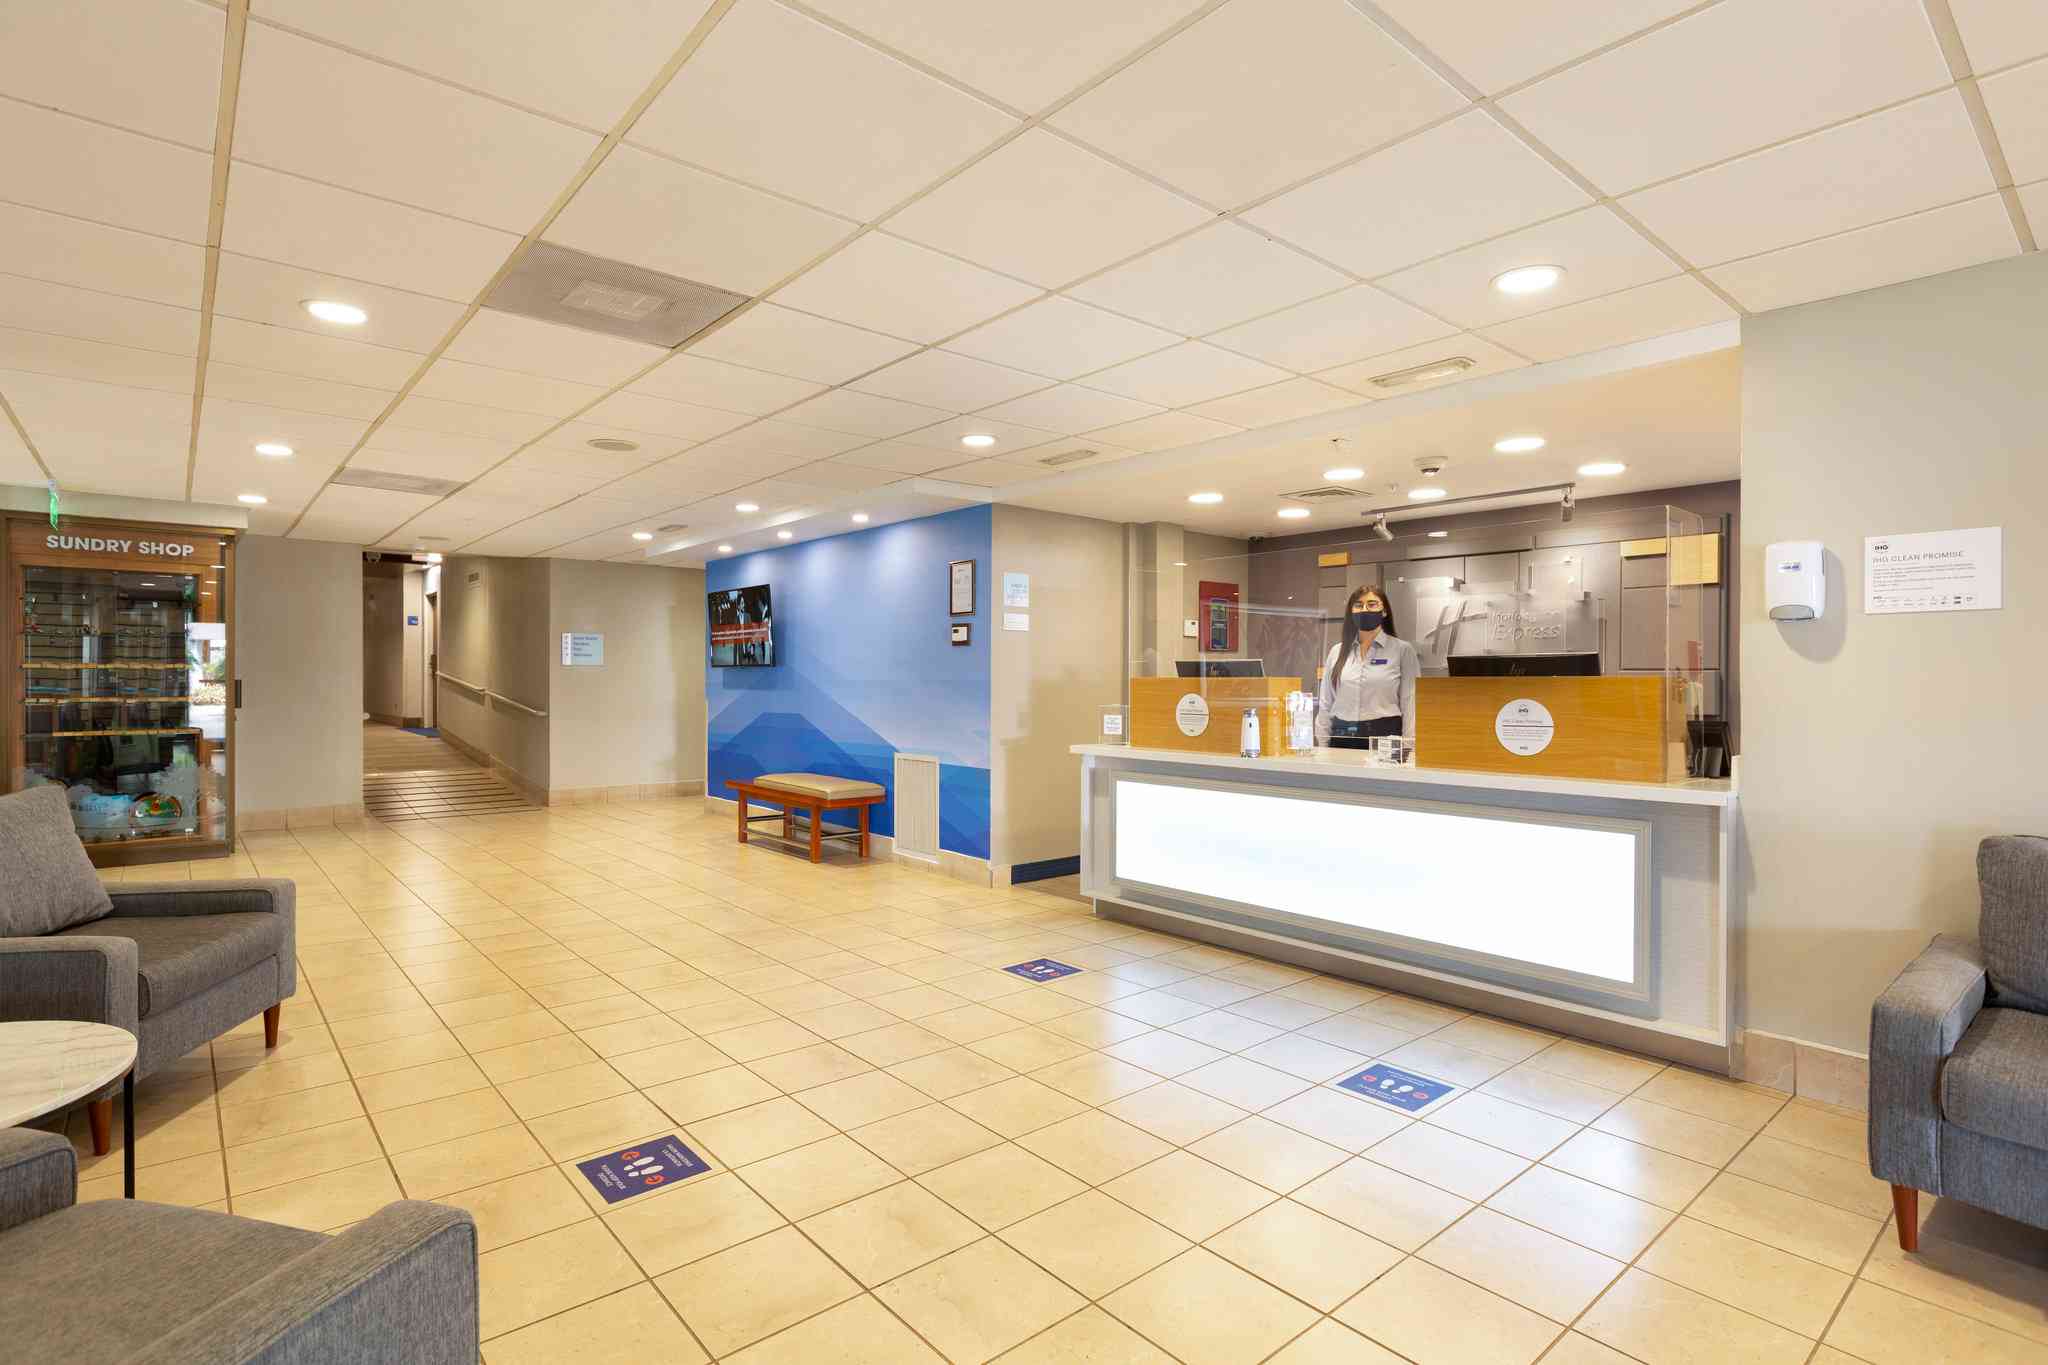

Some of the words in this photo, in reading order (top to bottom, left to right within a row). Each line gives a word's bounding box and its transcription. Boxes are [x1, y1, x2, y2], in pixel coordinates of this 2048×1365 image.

[46, 534, 132, 553] SUNDRY
[138, 541, 194, 557] SHOP
[1890, 552, 1921, 562] CLEAN
[1922, 550, 1965, 560] PROMISE
